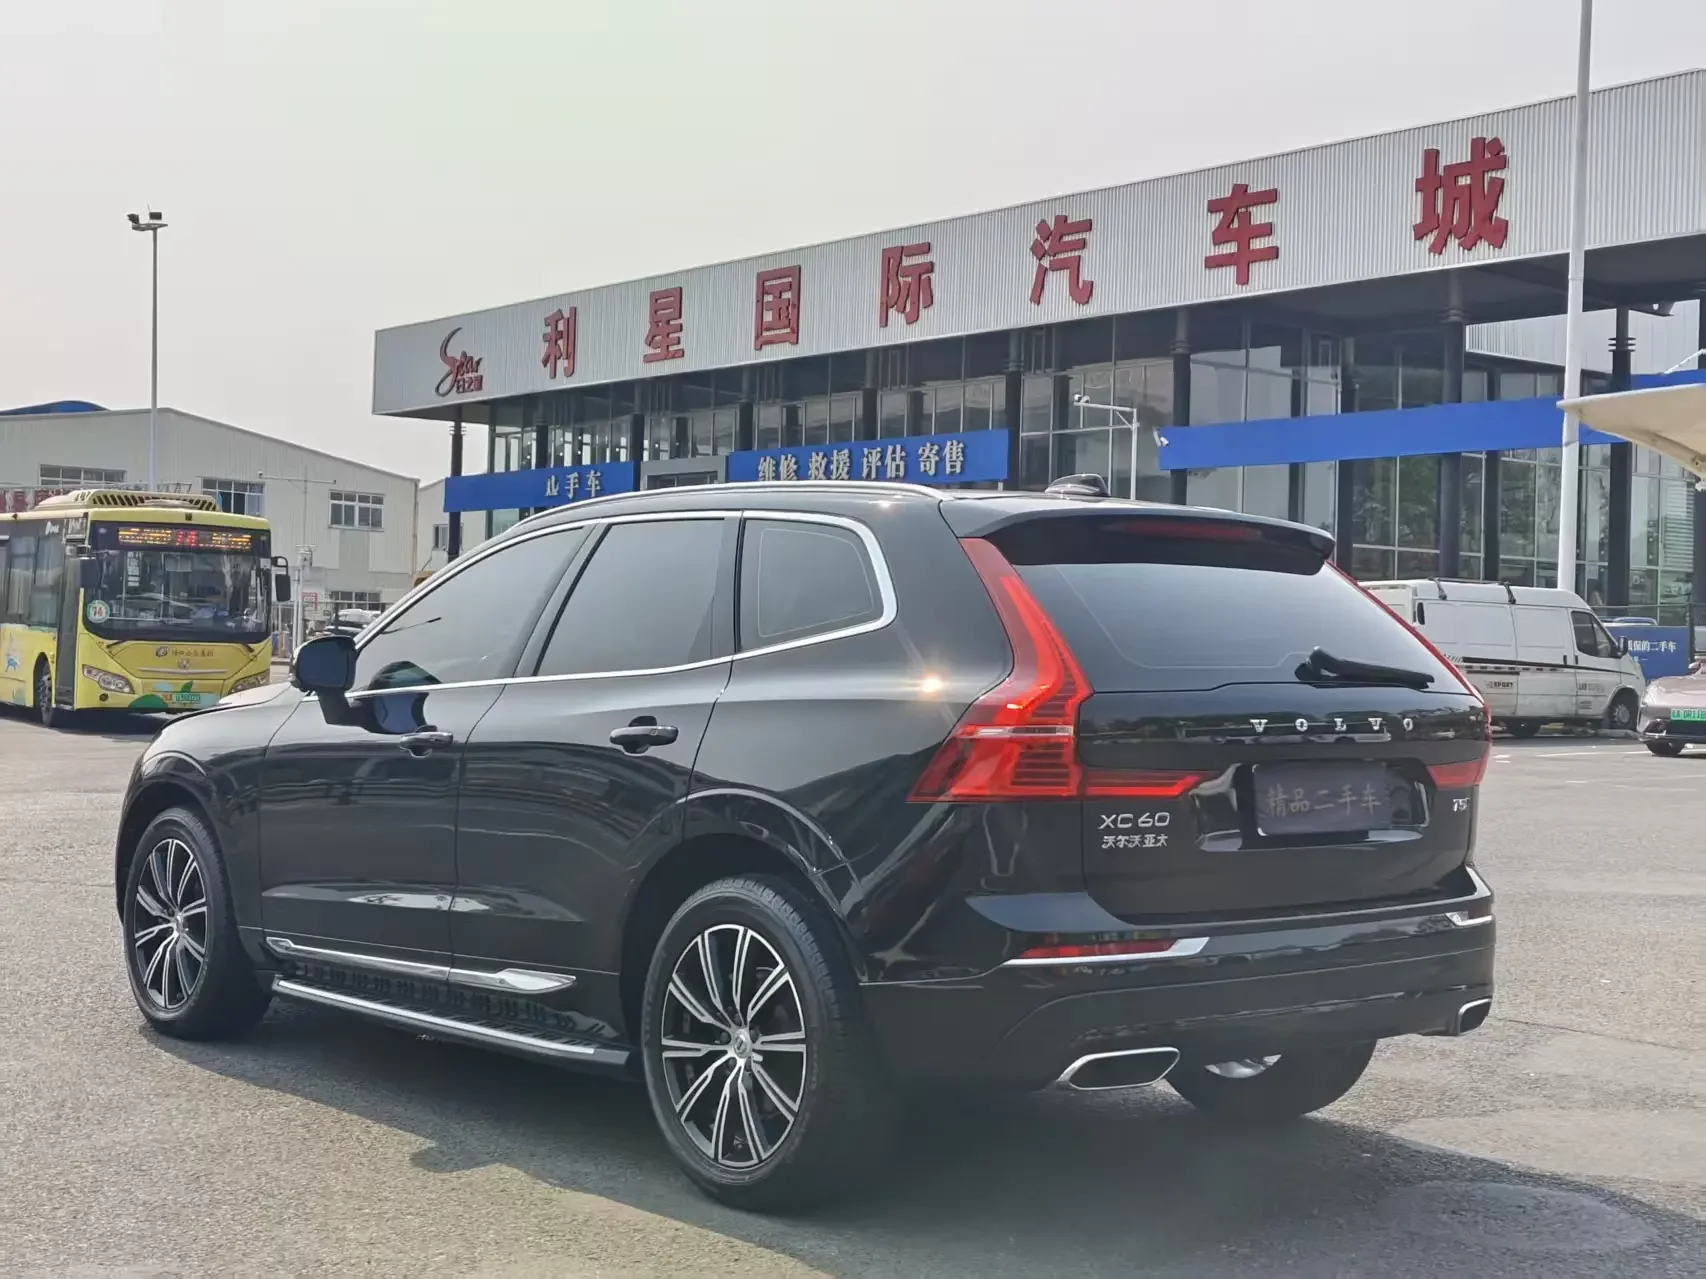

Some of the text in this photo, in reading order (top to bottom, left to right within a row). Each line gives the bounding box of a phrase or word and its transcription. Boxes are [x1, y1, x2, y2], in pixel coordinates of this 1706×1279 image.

[541, 136, 1510, 378] 利星国际汽车城
[758, 439, 965, 481] 维修 救援 评估 寄售
[1249, 717, 1414, 733] VOLVO
[1265, 782, 1383, 819] 精品二手车
[1101, 833, 1169, 849] 沃尔沃亚太
